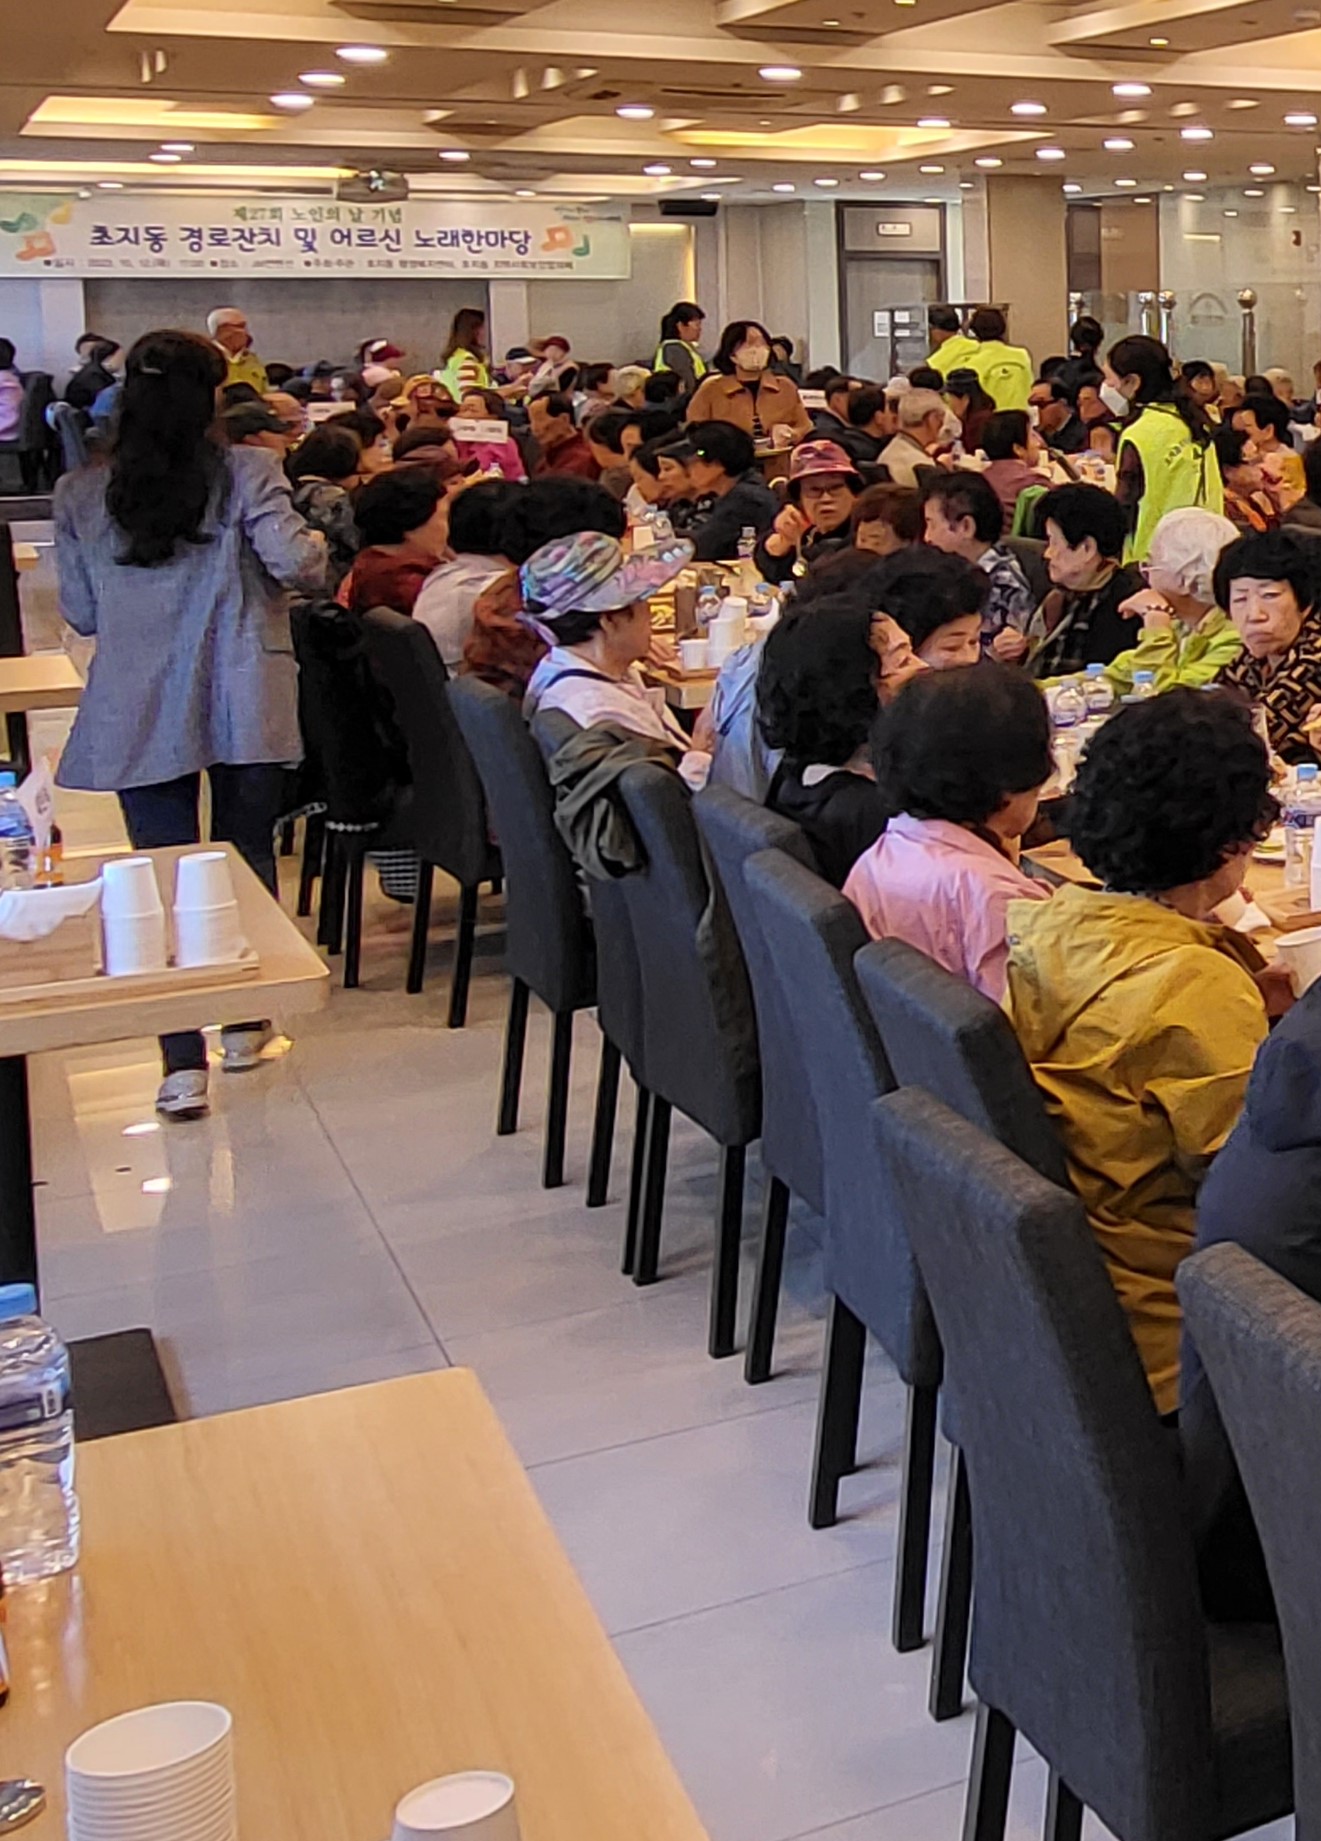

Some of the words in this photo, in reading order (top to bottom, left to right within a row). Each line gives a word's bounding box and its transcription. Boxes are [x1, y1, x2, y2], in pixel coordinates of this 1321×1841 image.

[90, 225, 168, 253] 초지동
[179, 226, 282, 253] 경로잔치
[293, 228, 318, 254] 및
[330, 228, 402, 253] 어르신
[414, 229, 532, 255] 노래한마당
